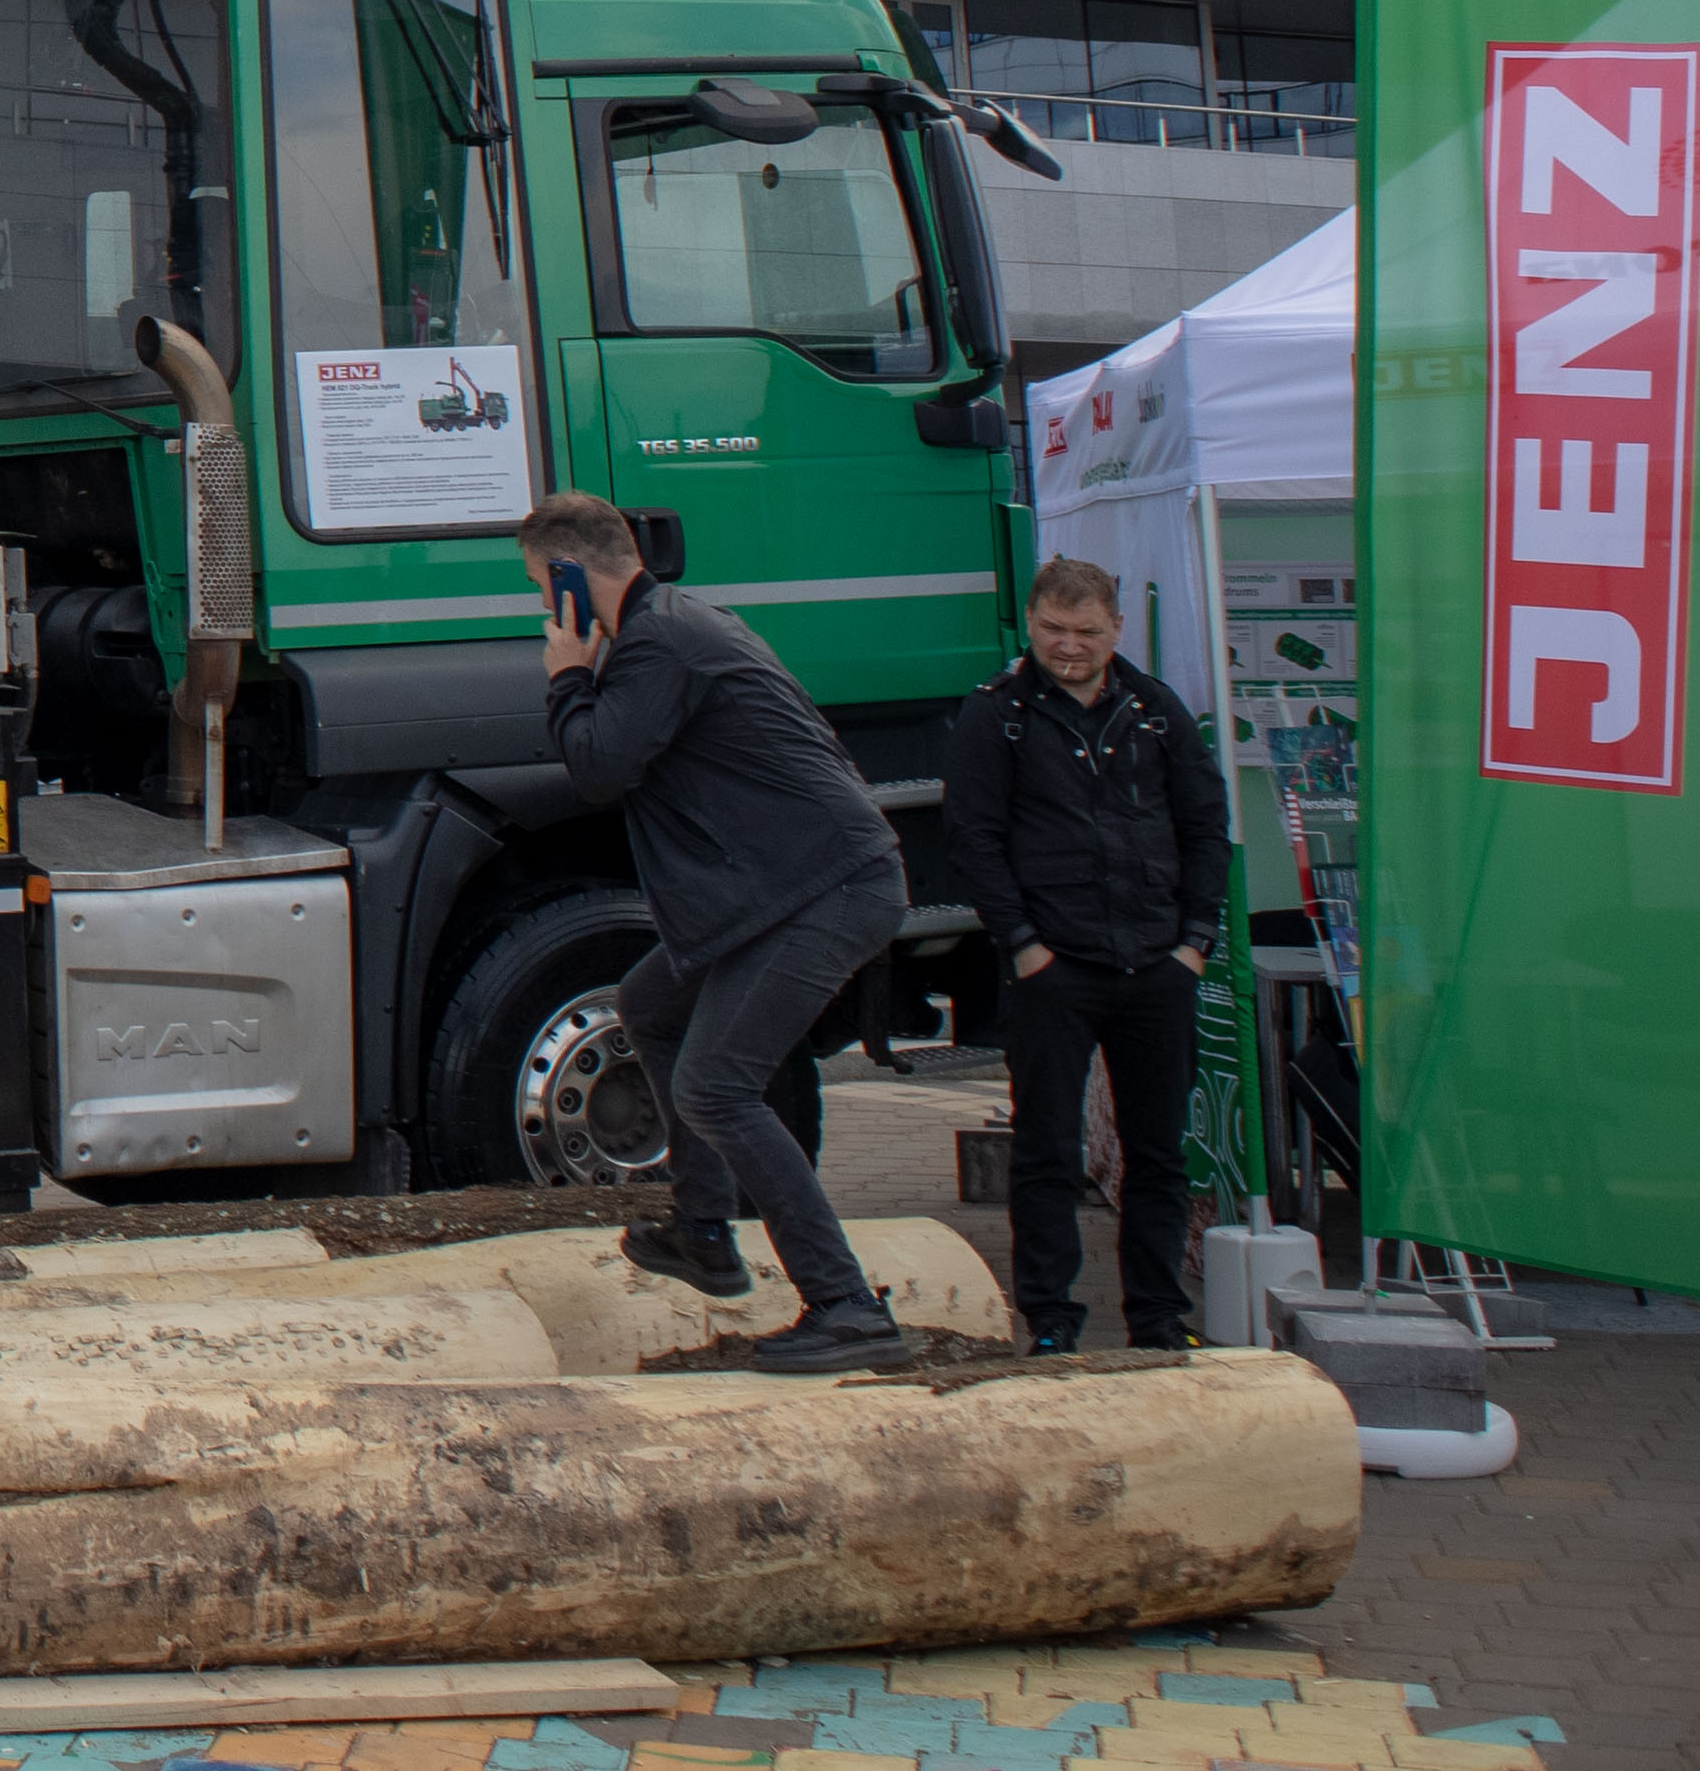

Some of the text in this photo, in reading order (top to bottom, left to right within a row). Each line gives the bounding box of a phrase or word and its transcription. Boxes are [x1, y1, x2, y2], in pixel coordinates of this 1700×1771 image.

[320, 365, 379, 380] JENZ
[1508, 85, 1663, 744] JENZ
[637, 436, 760, 456] TGS 35.500
[97, 1018, 261, 1062] MAN
